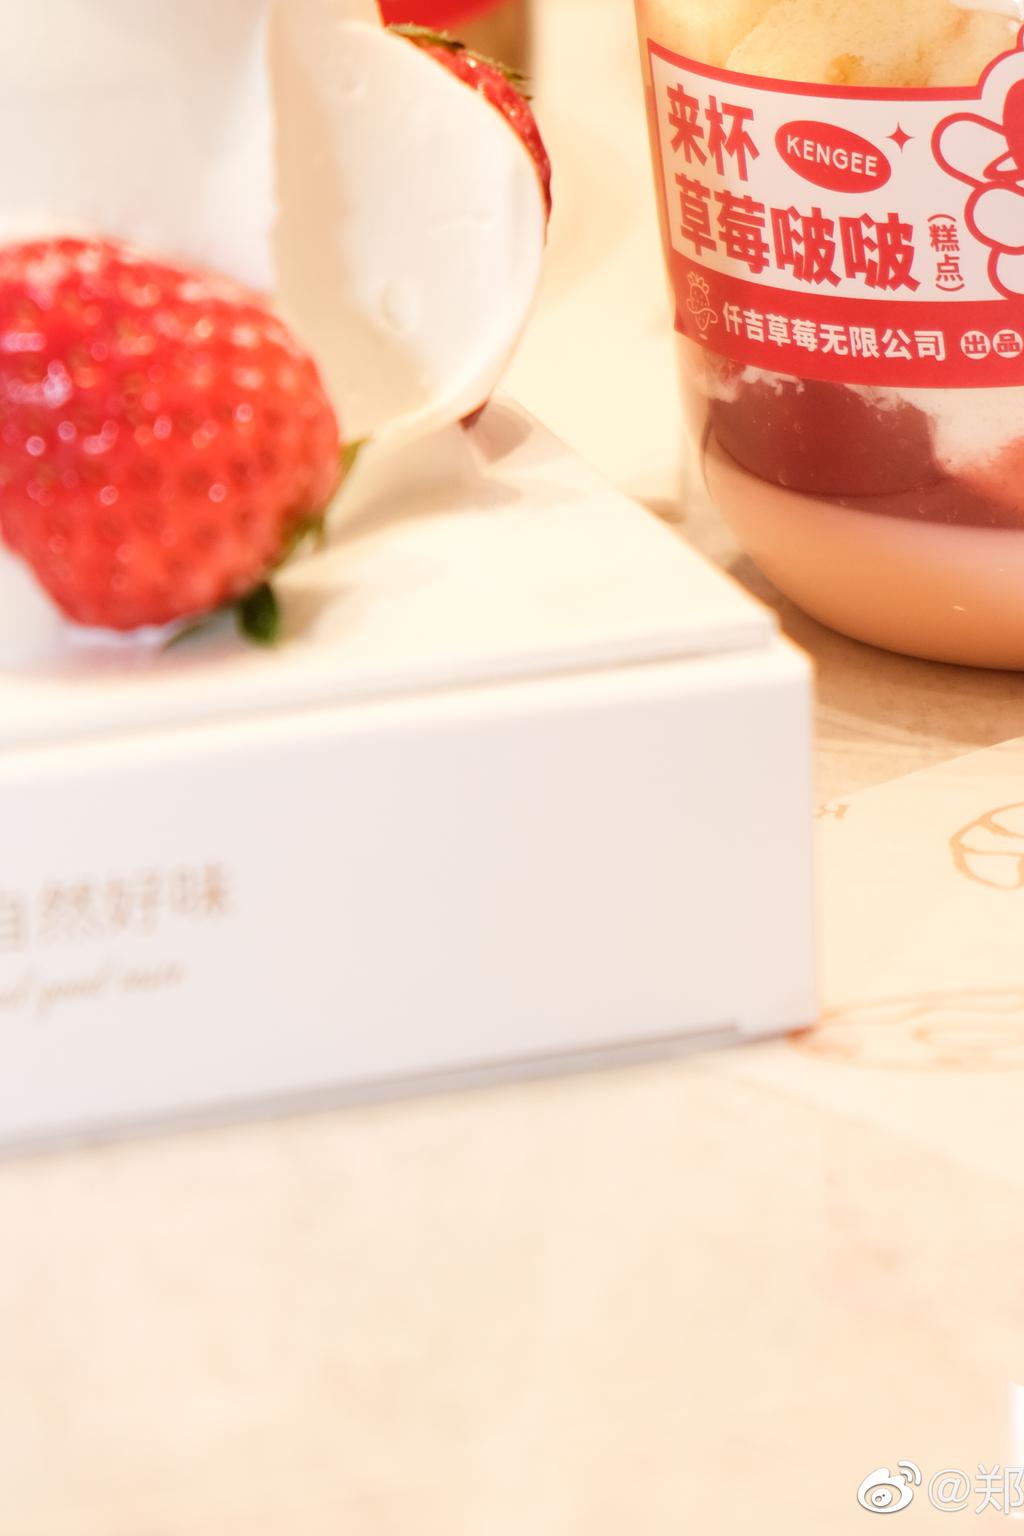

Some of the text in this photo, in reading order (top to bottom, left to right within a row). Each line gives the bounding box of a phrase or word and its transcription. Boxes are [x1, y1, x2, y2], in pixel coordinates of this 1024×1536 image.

[667, 82, 760, 182] 来杯
[785, 133, 879, 178] KENGEE
[674, 171, 921, 292] 草莓啵啵
[722, 301, 1024, 362] 仟吉草莓无限公司 出品
